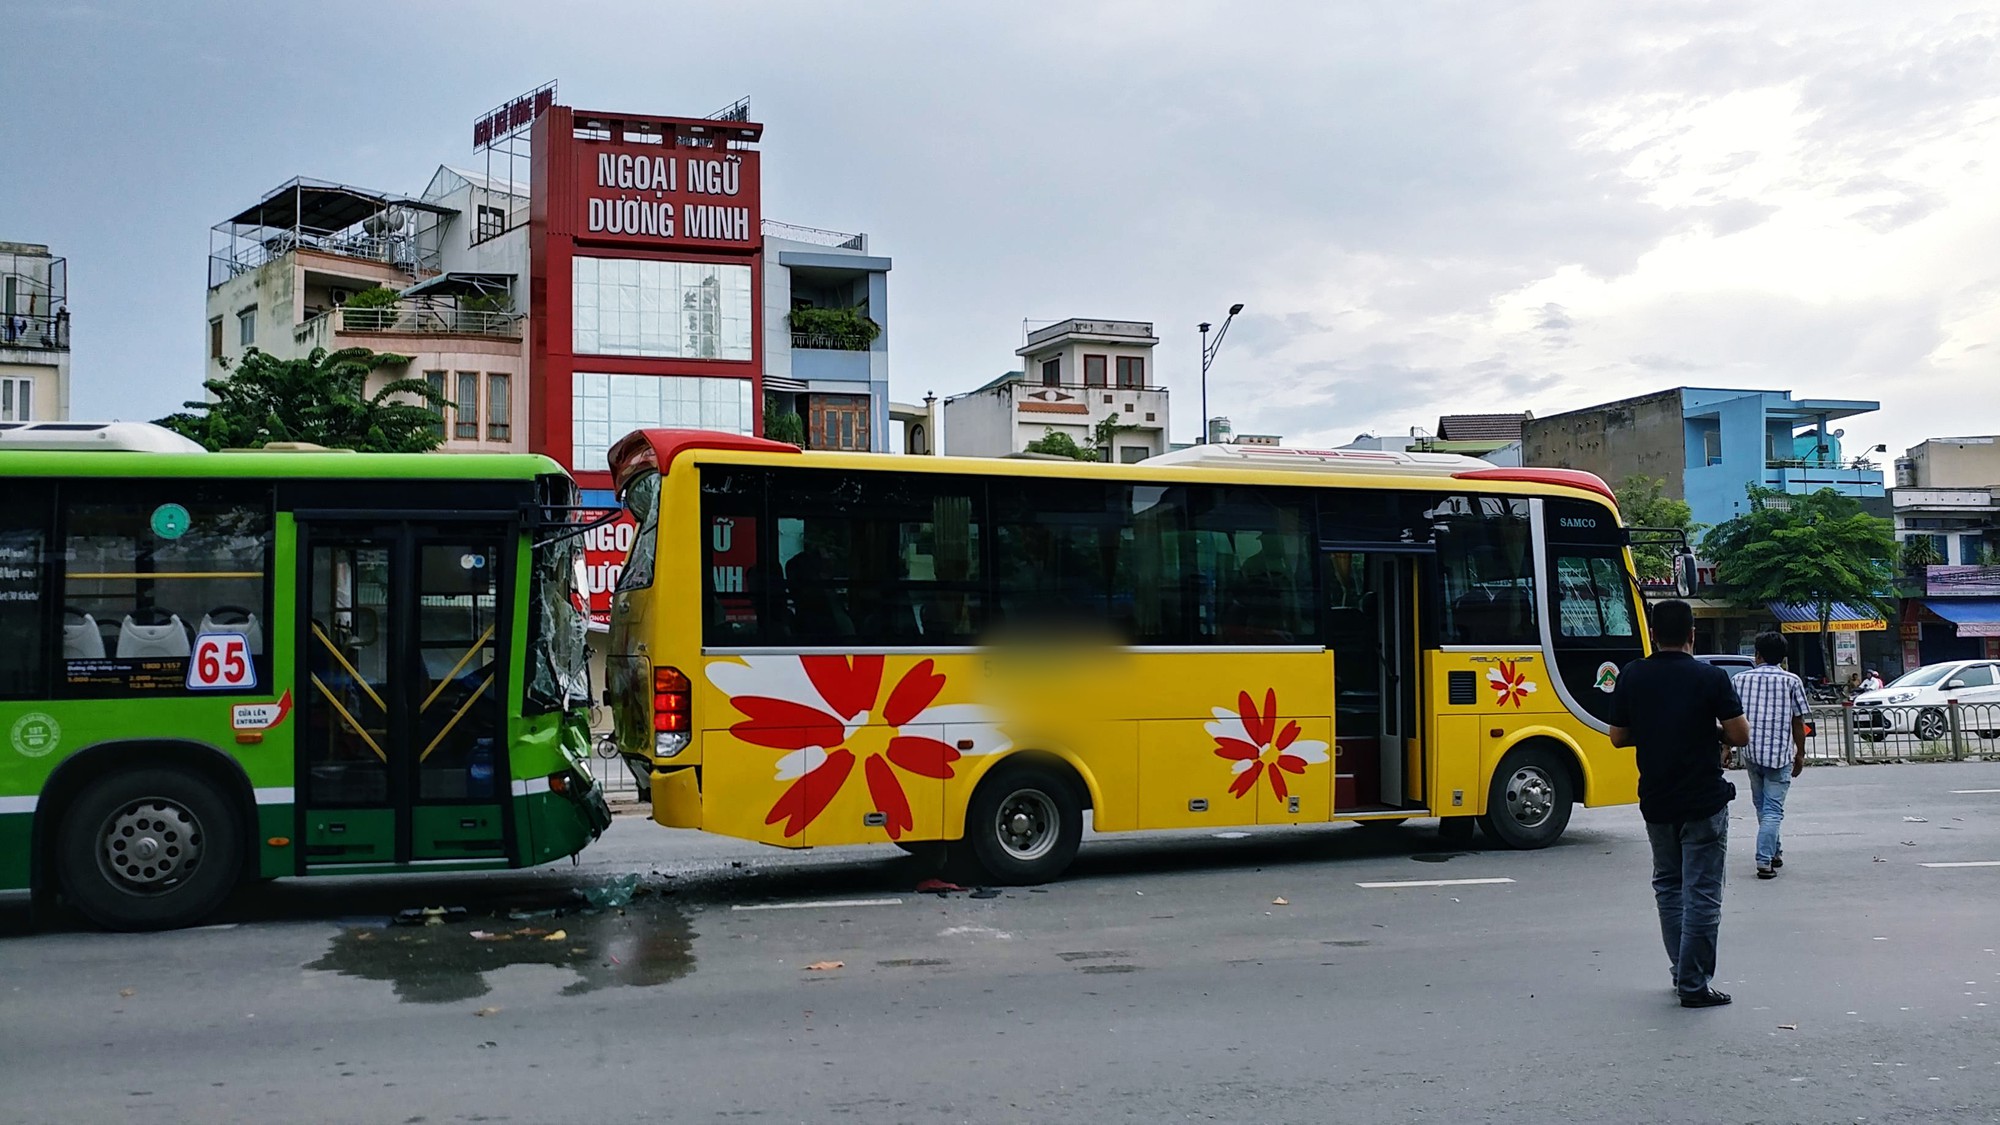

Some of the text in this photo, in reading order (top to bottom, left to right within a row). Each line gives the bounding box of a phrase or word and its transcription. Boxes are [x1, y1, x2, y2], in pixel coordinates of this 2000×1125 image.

[598, 153, 742, 198] NGOẠI NGỮ
[589, 194, 749, 241] DƯƠNG MINH
[583, 523, 634, 552] NGO
[713, 517, 734, 552] Ữ
[1560, 517, 1596, 528] SAMCO
[713, 566, 743, 593] NH
[197, 642, 246, 684] 65
[238, 708, 267, 717] CỬA LÊN
